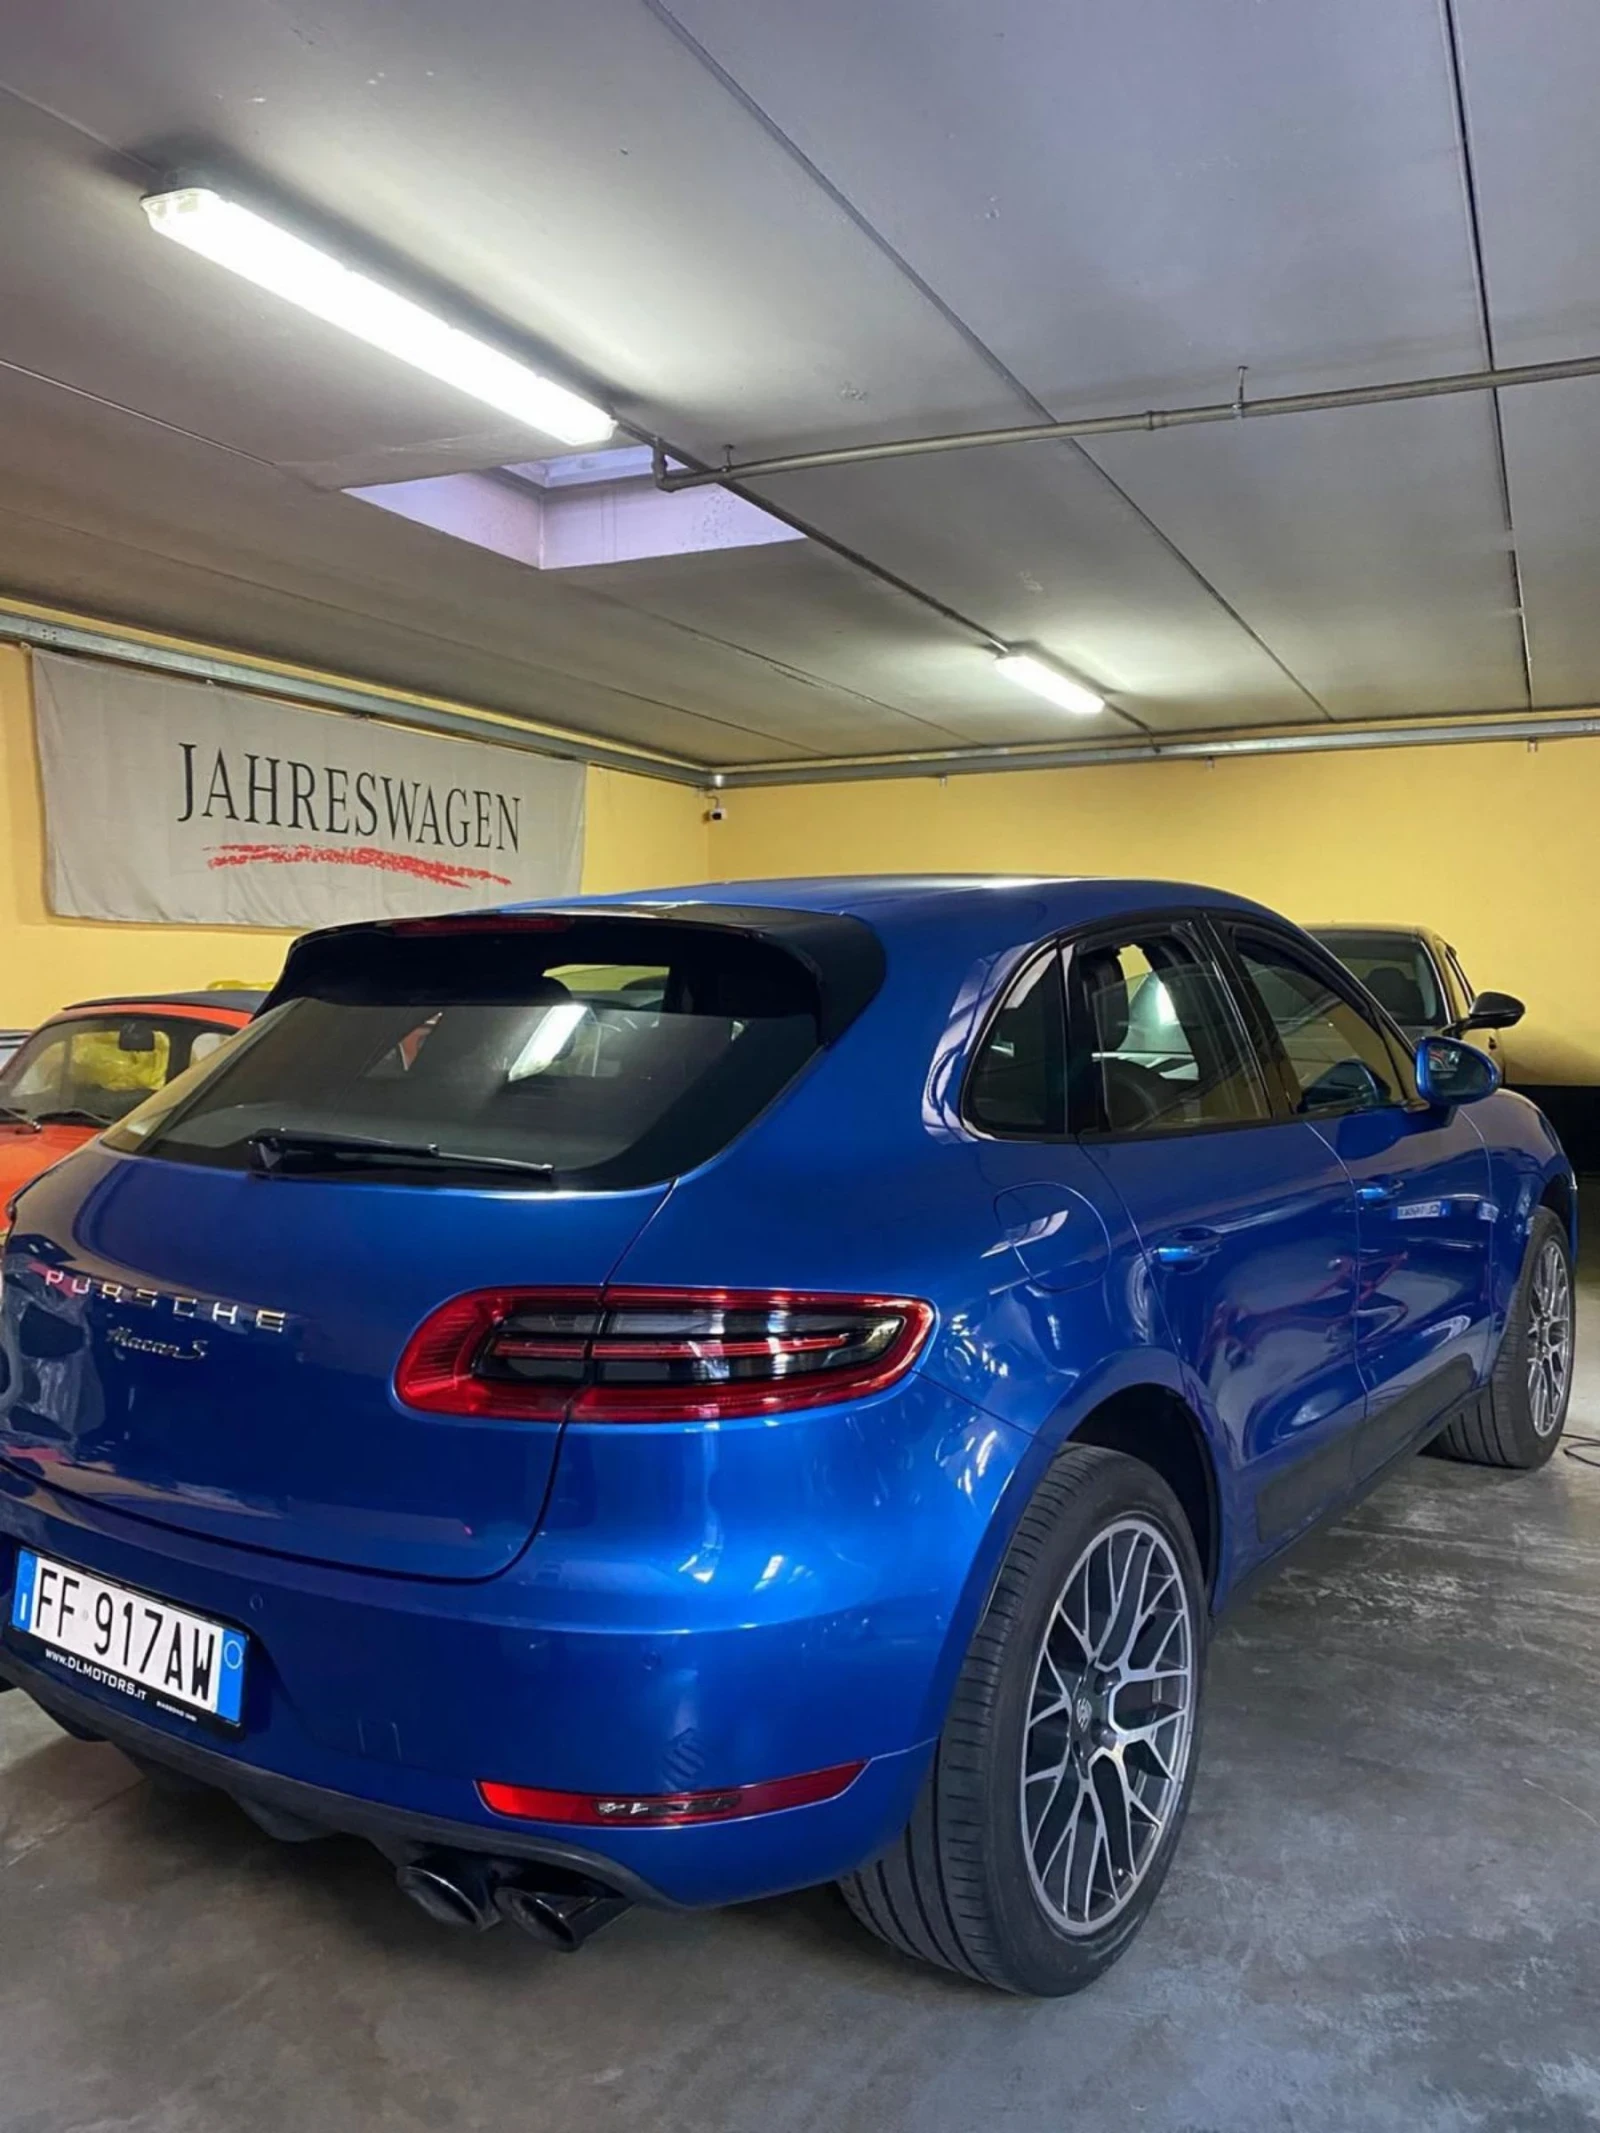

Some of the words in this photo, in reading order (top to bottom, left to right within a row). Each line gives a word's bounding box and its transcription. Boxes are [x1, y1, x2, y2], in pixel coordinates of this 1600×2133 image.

[177, 743, 522, 853] JAHRESWAGEN
[46, 1269, 286, 1333] PORSCHE
[106, 1326, 180, 1359] Macan
[35, 1567, 80, 1638] FF
[93, 1591, 215, 1701] 917AW
